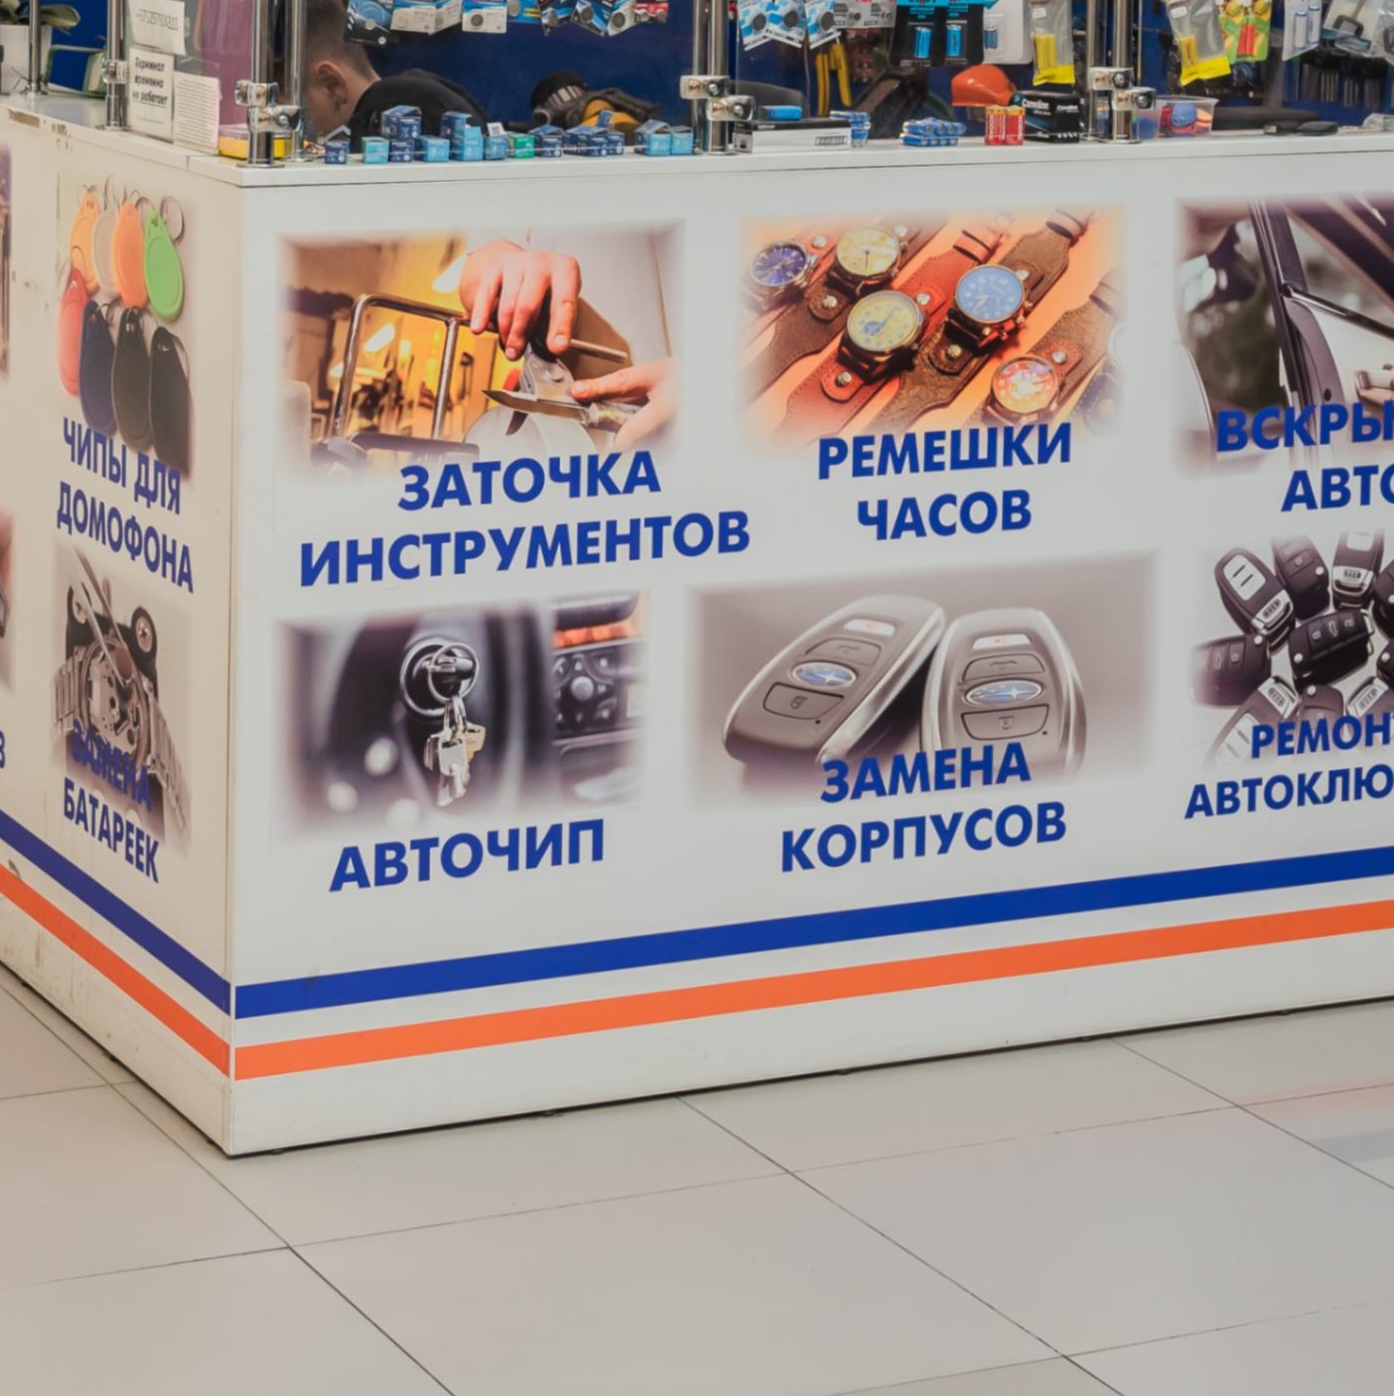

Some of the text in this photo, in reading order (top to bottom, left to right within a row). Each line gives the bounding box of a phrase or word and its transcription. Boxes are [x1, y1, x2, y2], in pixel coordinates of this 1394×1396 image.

[134, 77, 164, 89] временно
[135, 57, 165, 73] Терминал
[63, 417, 181, 515] ЧИПЫ ДЛЯ
[398, 451, 661, 511] ЗАТОЧКА
[818, 422, 1072, 480] РЕМЕШКИ
[57, 481, 193, 593] ДОМОФОНА
[300, 511, 750, 587] ИНСТРУМЕНТОВ
[857, 489, 1032, 541] ЧАСОВ
[72, 720, 152, 811] ЗАМЕНА
[820, 742, 1032, 803] ЗАМЕНА
[63, 778, 159, 883] БАТАРЕЕК
[329, 819, 604, 893] АВТОЧИП
[782, 801, 1067, 873] КОРПУСОВ
